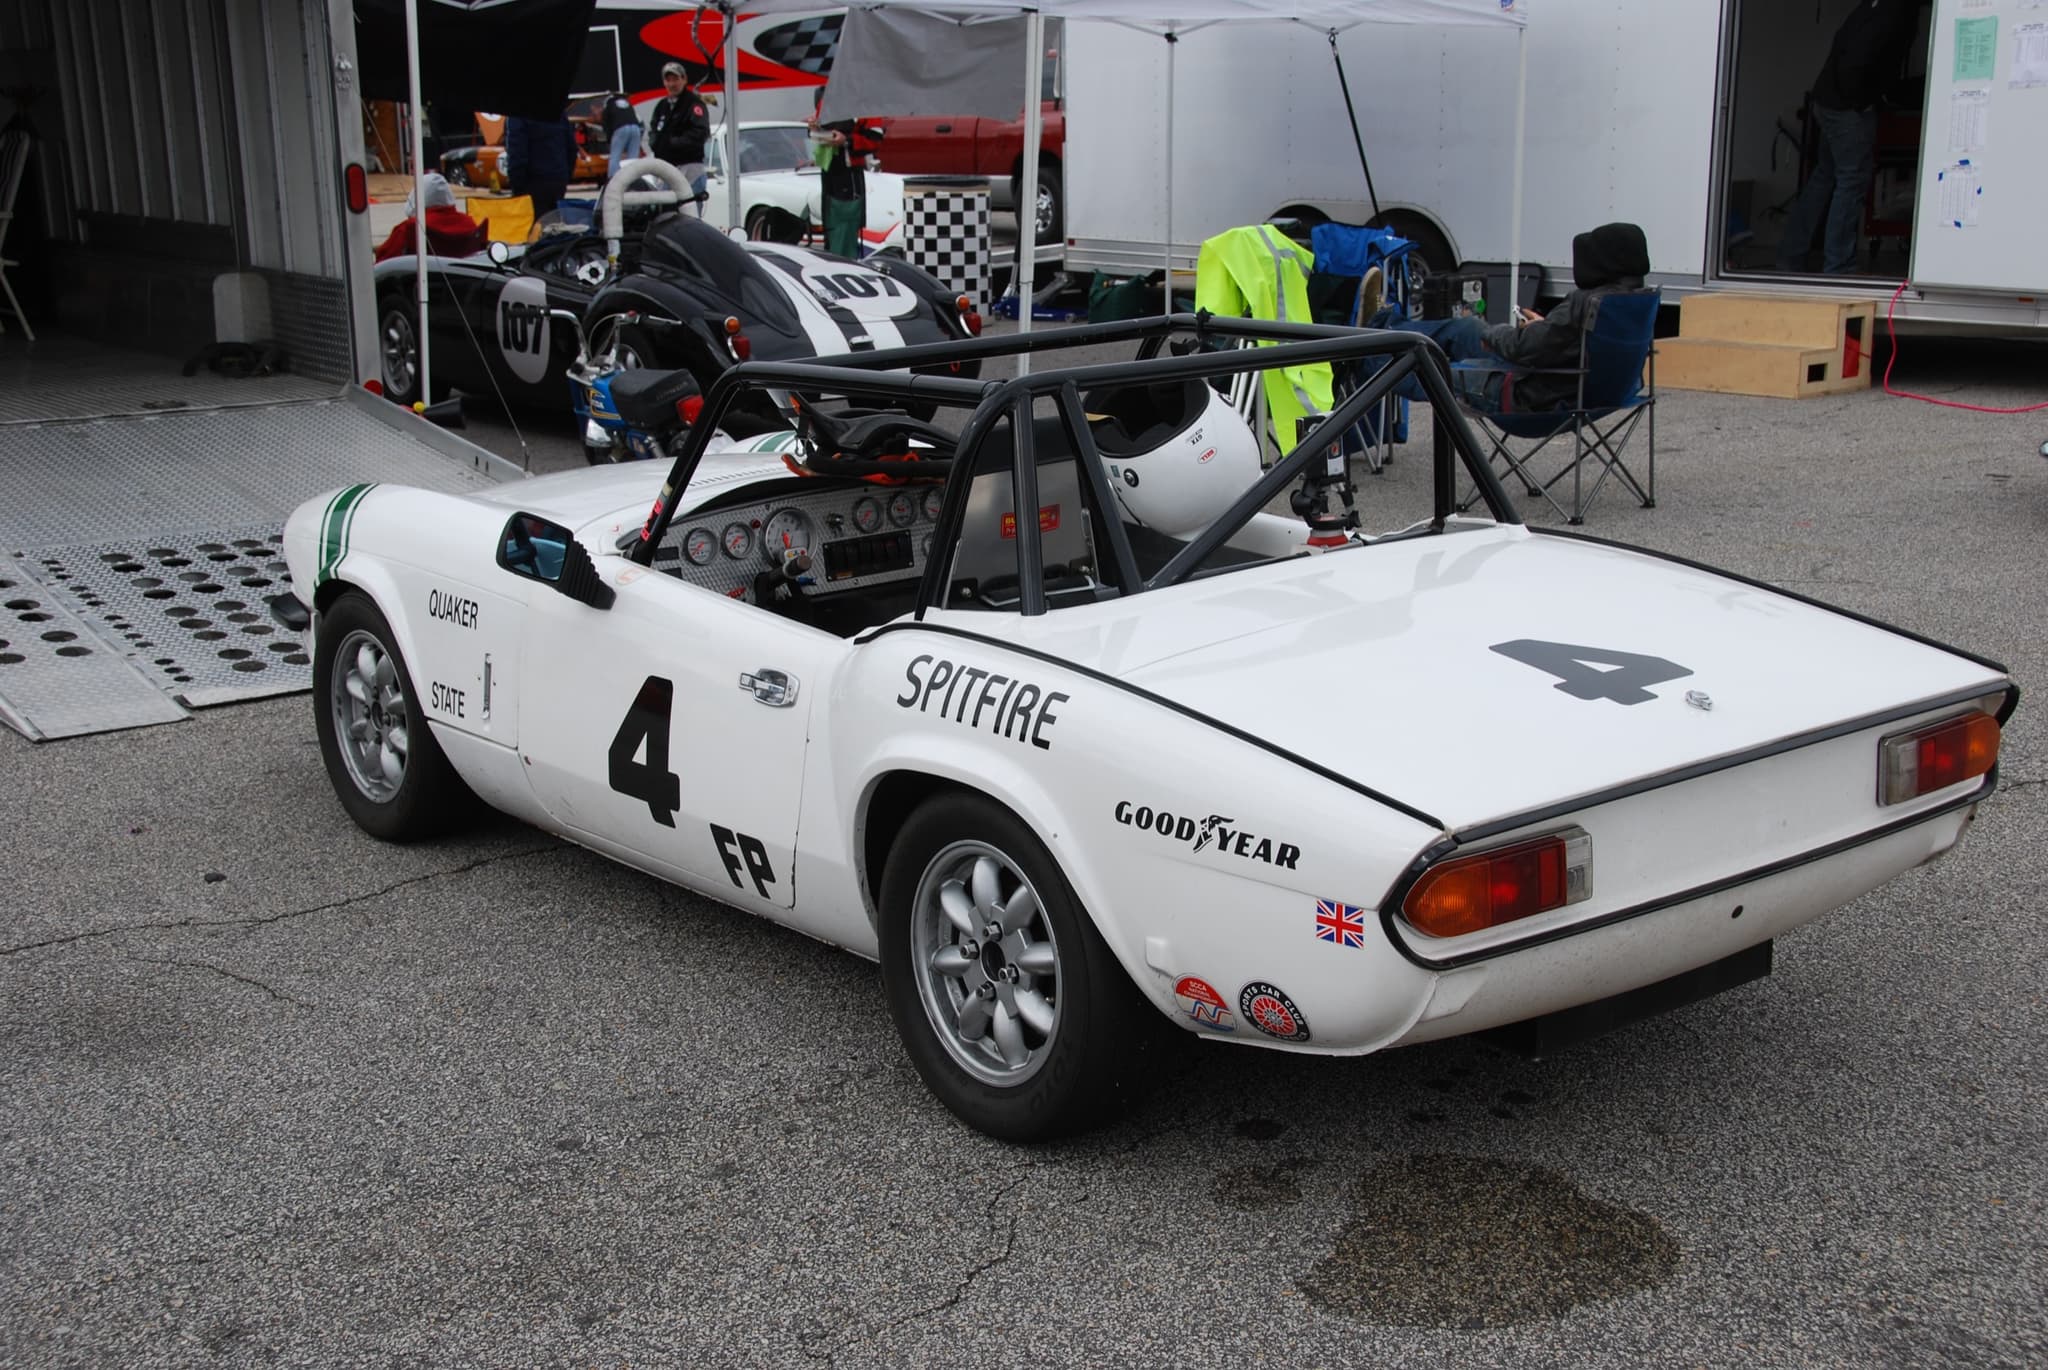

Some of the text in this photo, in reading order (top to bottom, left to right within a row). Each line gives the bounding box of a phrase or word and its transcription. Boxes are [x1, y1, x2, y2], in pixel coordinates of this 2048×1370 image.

[809, 273, 902, 300] 107
[501, 300, 546, 355] 107
[429, 588, 479, 631] QUAKER
[431, 680, 465, 719] STATE
[1487, 638, 1695, 706] 4
[896, 654, 1071, 751] SPITFIRE
[608, 674, 681, 829] 4
[709, 822, 776, 900] FP
[1242, 984, 1305, 1025] SPORTS CAR CLUB
